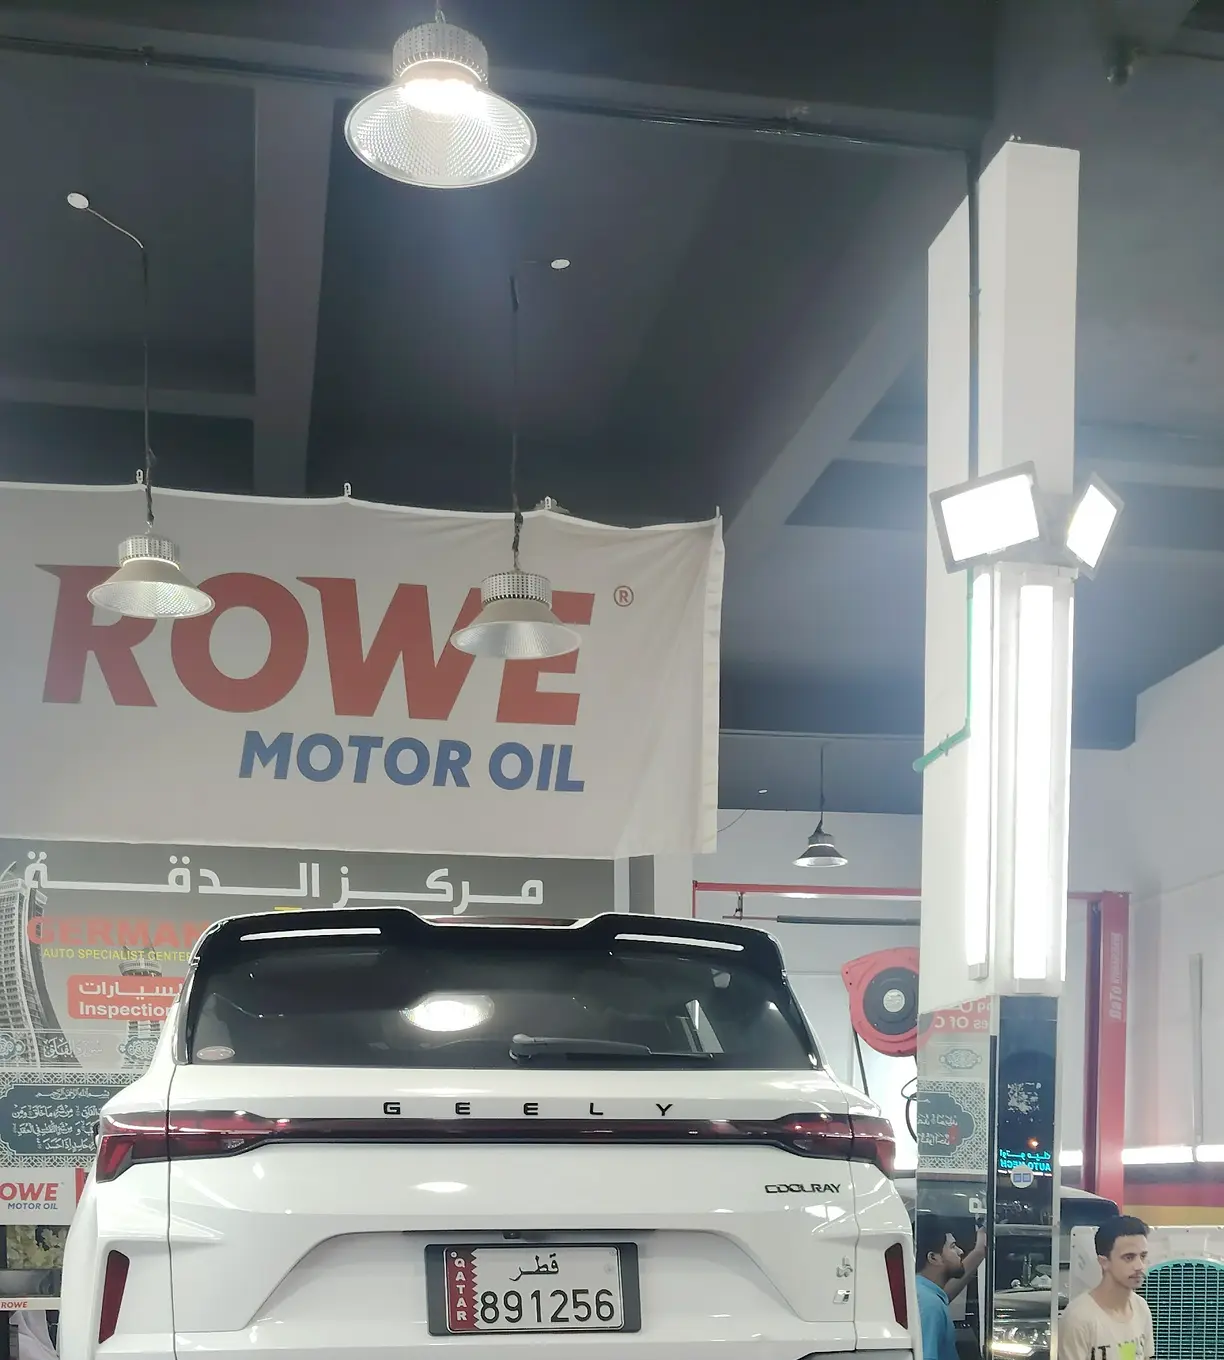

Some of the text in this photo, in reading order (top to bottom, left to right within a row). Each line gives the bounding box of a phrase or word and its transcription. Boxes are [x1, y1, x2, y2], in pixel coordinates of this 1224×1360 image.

[35, 564, 595, 726] ROWE
[239, 730, 586, 792] MOTOR OIL
[25, 850, 543, 914] مركز الدقة
[43, 948, 75, 959] AUTO
[78, 949, 147, 960] SPECIALIST
[79, 982, 184, 1000] لسيارات
[383, 1102, 673, 1116] GEELY
[0, 1182, 59, 1201] OWE
[764, 1183, 841, 1193] COOLRAY
[8, 1202, 41, 1210] MOTOR
[509, 1253, 560, 1281] قطر
[454, 1258, 467, 1321] QATAR
[1, 1301, 28, 1309] ROWE
[480, 1288, 615, 1324] 891256
